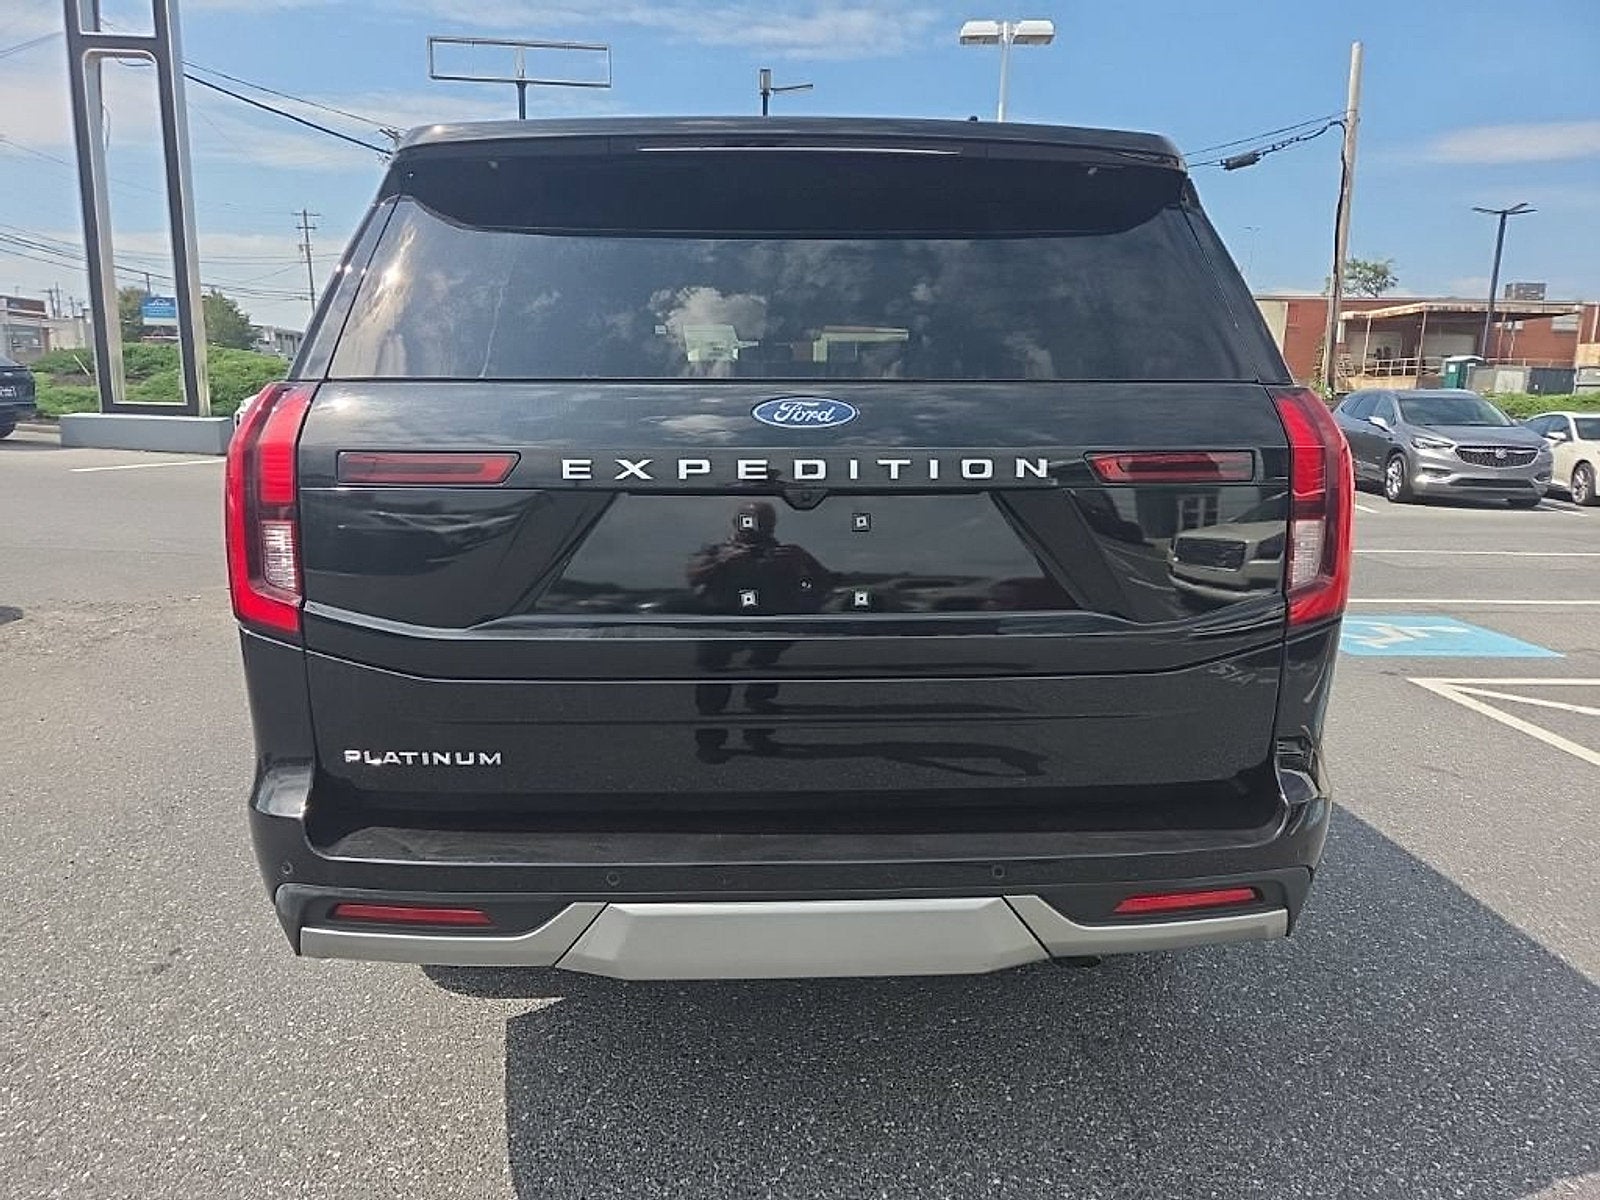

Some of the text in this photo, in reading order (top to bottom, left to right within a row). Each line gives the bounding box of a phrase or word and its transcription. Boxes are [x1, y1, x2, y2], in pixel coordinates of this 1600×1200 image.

[772, 400, 837, 425] Ford
[561, 458, 1050, 481] EXPEDITION
[343, 749, 503, 766] PLATINUM
